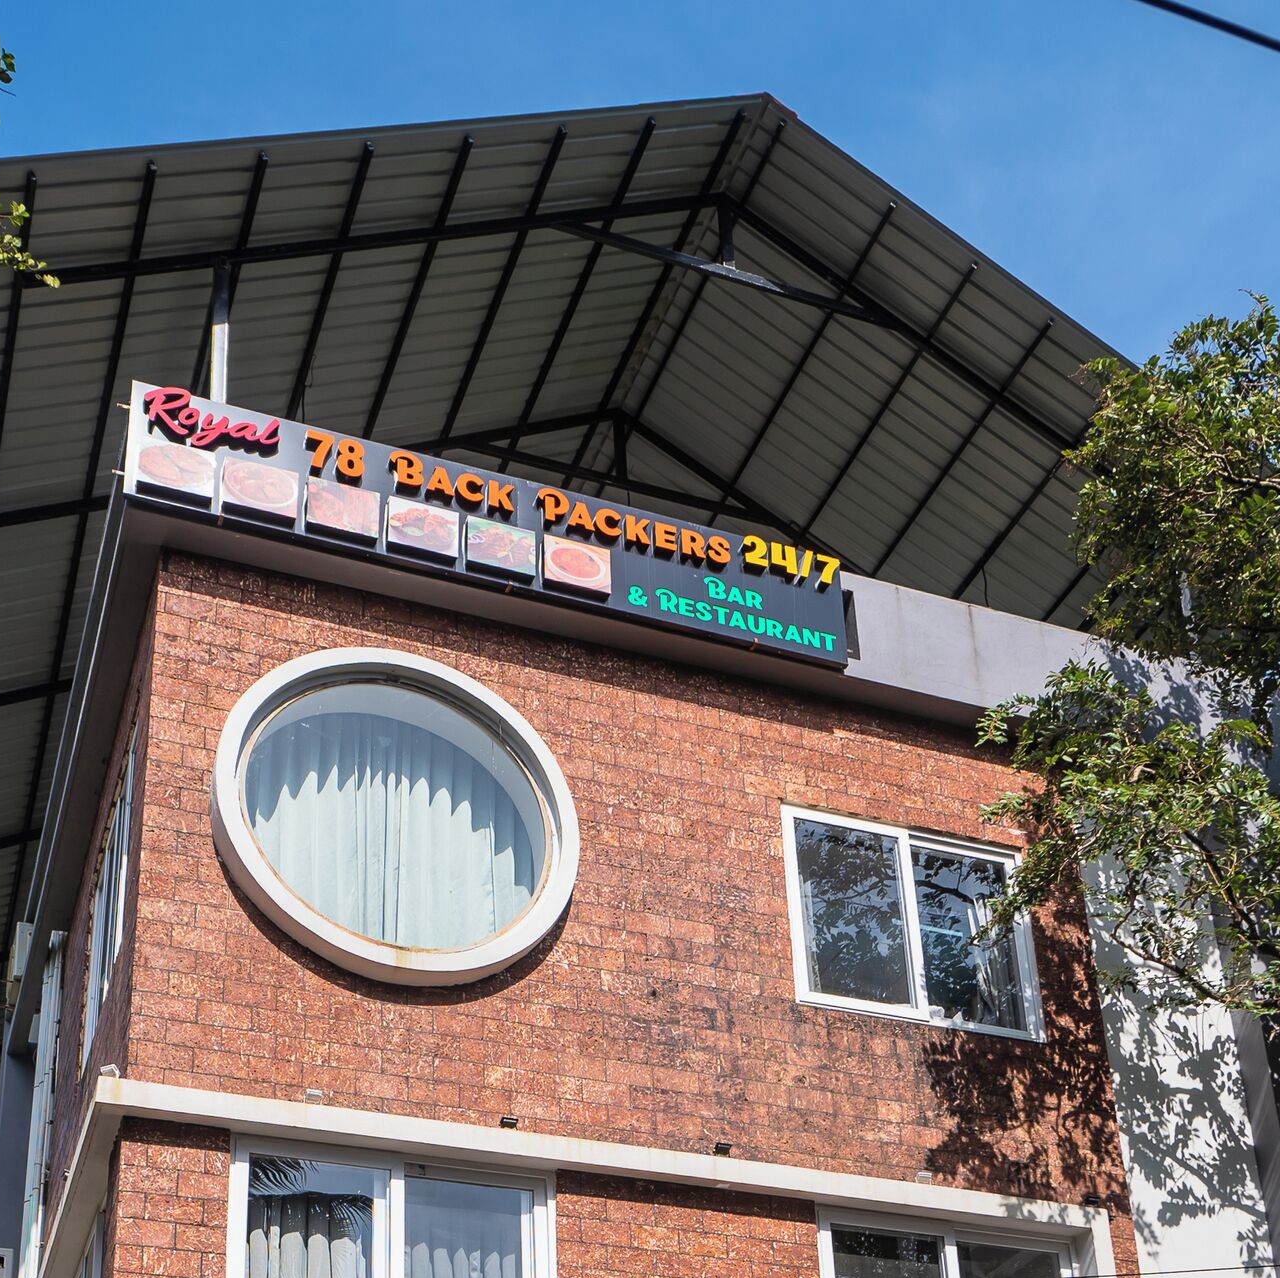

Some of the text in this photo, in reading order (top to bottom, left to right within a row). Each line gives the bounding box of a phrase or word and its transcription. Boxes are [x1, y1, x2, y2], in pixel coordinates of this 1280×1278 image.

[144, 387, 840, 585] Royal 78 BACK PACKERS 24/7
[628, 585, 837, 651] & RESTAURANT
[704, 576, 763, 610] BAR
